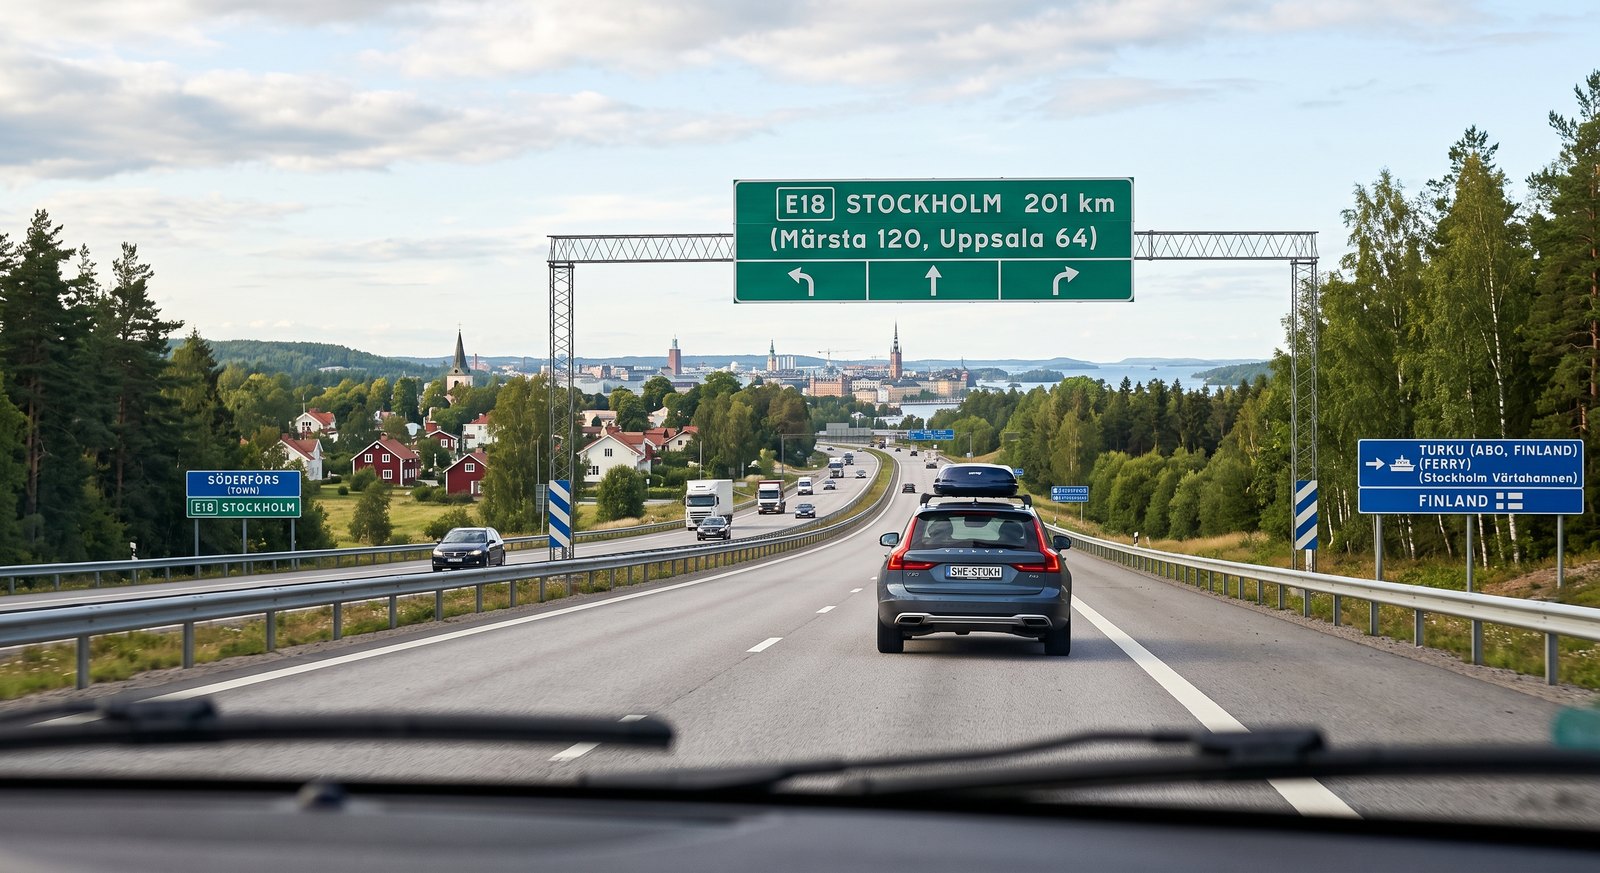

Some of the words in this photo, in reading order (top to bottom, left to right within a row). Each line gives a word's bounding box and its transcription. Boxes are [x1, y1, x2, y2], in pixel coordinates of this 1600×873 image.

[786, 194, 825, 214] E18
[846, 194, 1001, 213] STOCKHOLM
[1024, 193, 1067, 213] 201
[1079, 192, 1115, 212] km
[770, 227, 866, 251] (Märsta
[877, 228, 929, 251] 120,
[940, 228, 1044, 252] Uppsala
[1055, 226, 1097, 251] 64)
[1419, 444, 1464, 456] TURKU
[1470, 443, 1508, 458] (ABO,
[1514, 443, 1578, 457] FINLAND)
[1419, 458, 1471, 471] (FERRY)
[1419, 471, 1487, 484] (Stockholm
[1492, 471, 1578, 484] Värtahamnen)
[227, 486, 260, 495] (TOWN)
[195, 502, 214, 512] E18
[222, 502, 295, 512] STOCKHOLM
[1419, 494, 1488, 507] FINLAND
